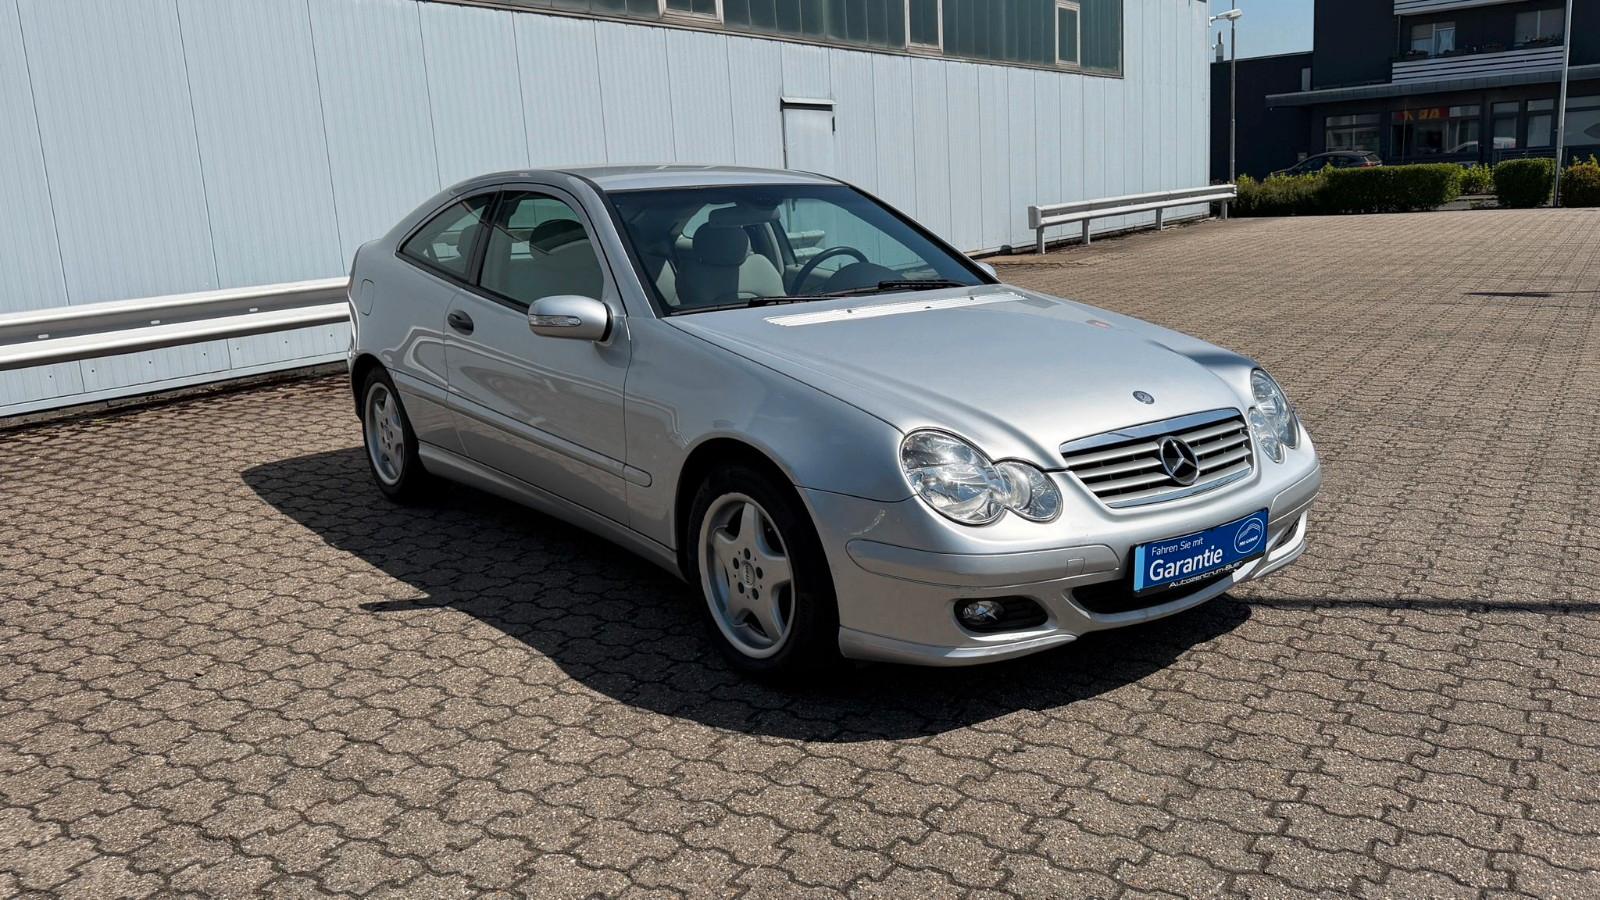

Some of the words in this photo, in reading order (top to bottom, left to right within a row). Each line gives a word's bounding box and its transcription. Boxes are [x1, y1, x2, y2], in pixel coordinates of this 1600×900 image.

[1151, 545, 1178, 556] Fahren
[1180, 541, 1191, 551] Sie
[1192, 537, 1204, 547] mit
[1149, 545, 1223, 581] Garantie
